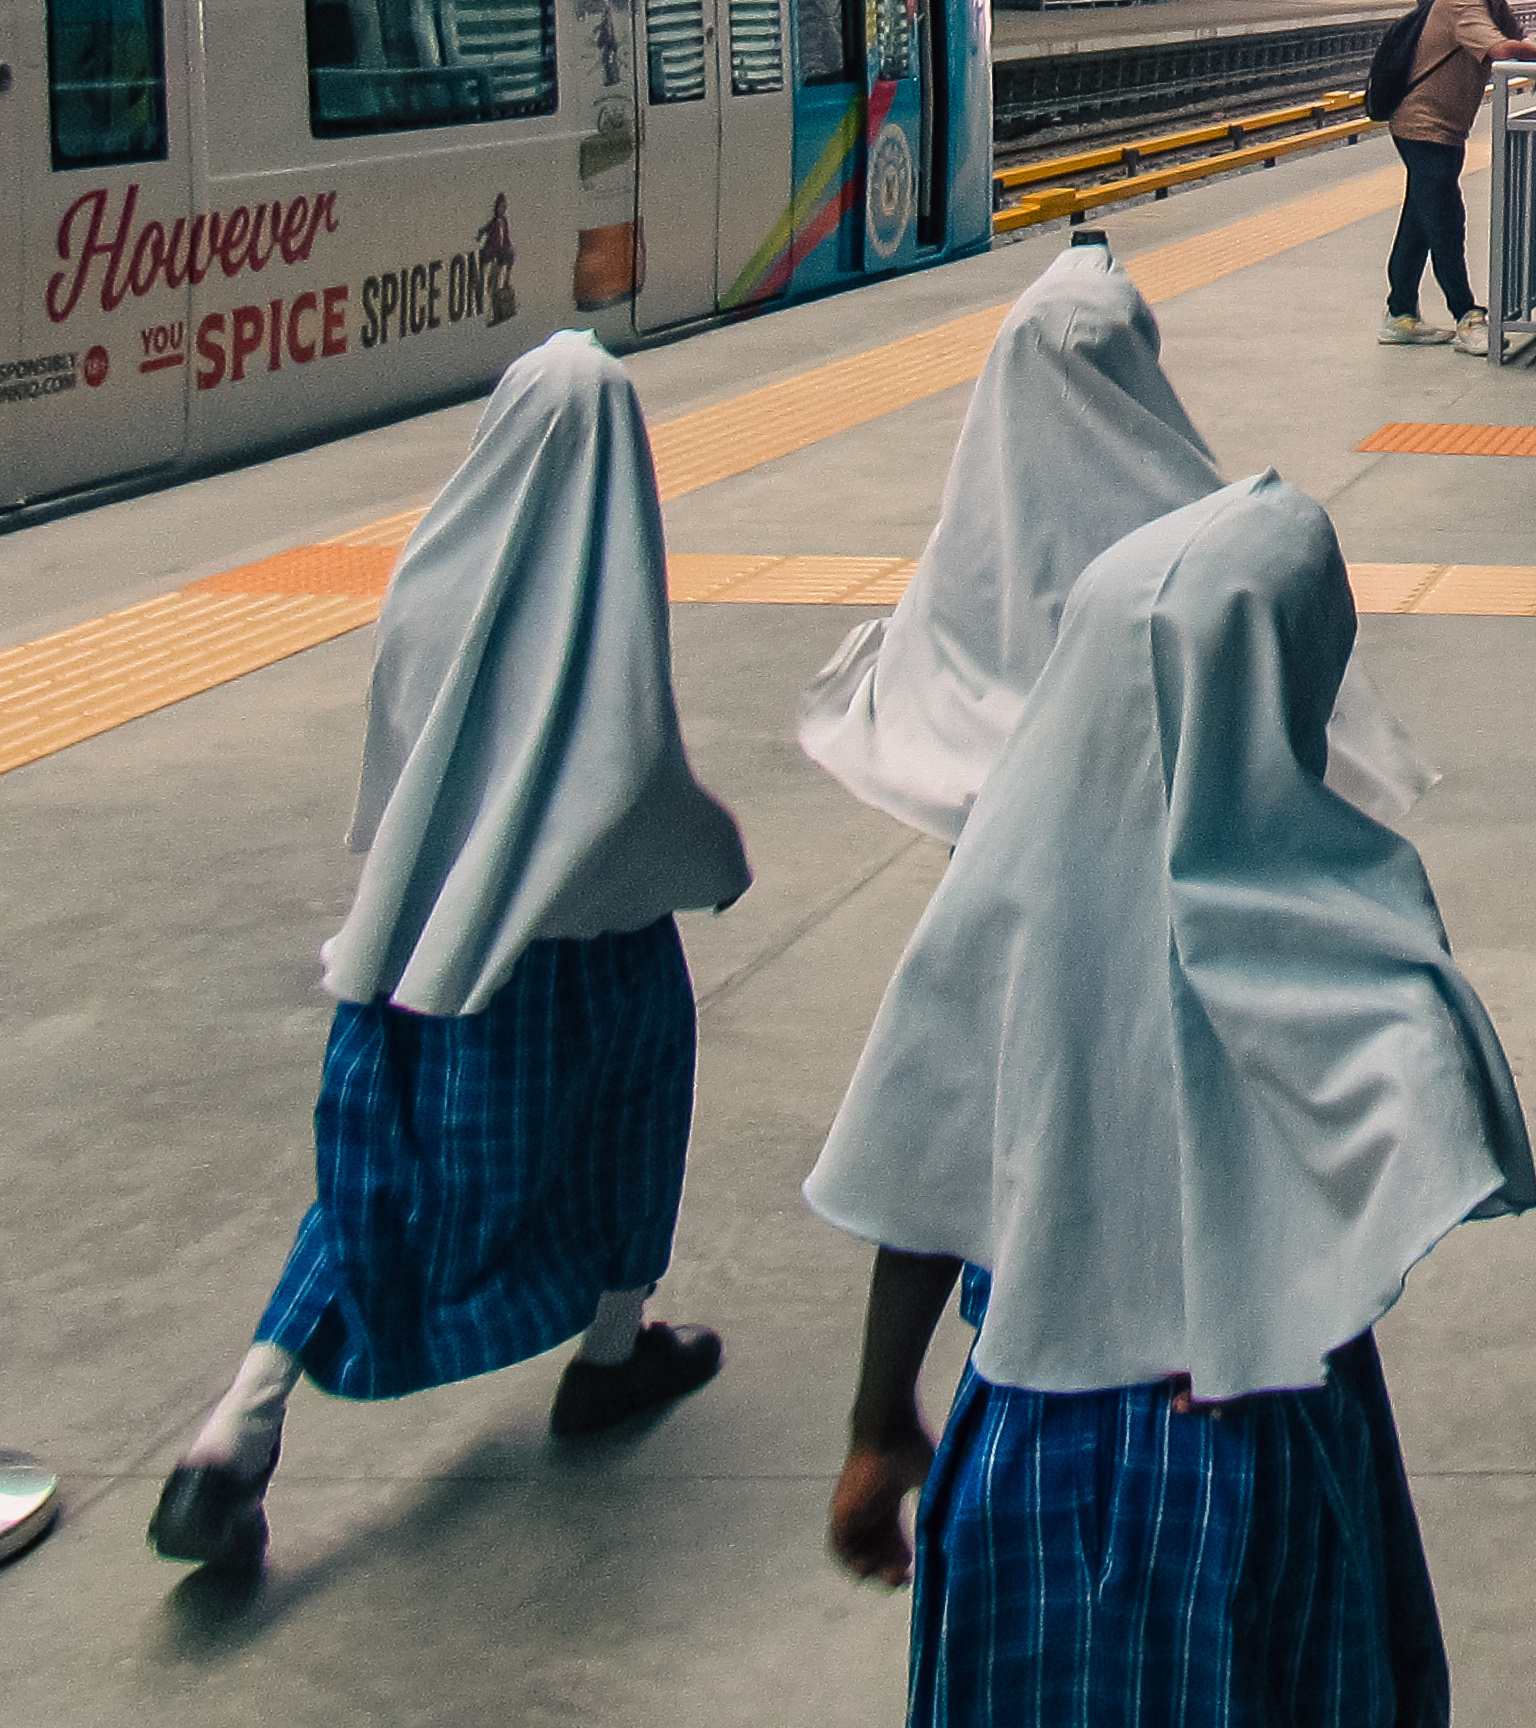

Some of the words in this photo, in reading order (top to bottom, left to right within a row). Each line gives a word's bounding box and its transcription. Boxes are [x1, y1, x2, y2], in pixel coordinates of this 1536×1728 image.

[46, 184, 340, 324] However
[140, 322, 184, 355] YOU
[197, 285, 349, 391] SPICE
[361, 260, 444, 349] SPICE
[449, 249, 484, 323] ON
